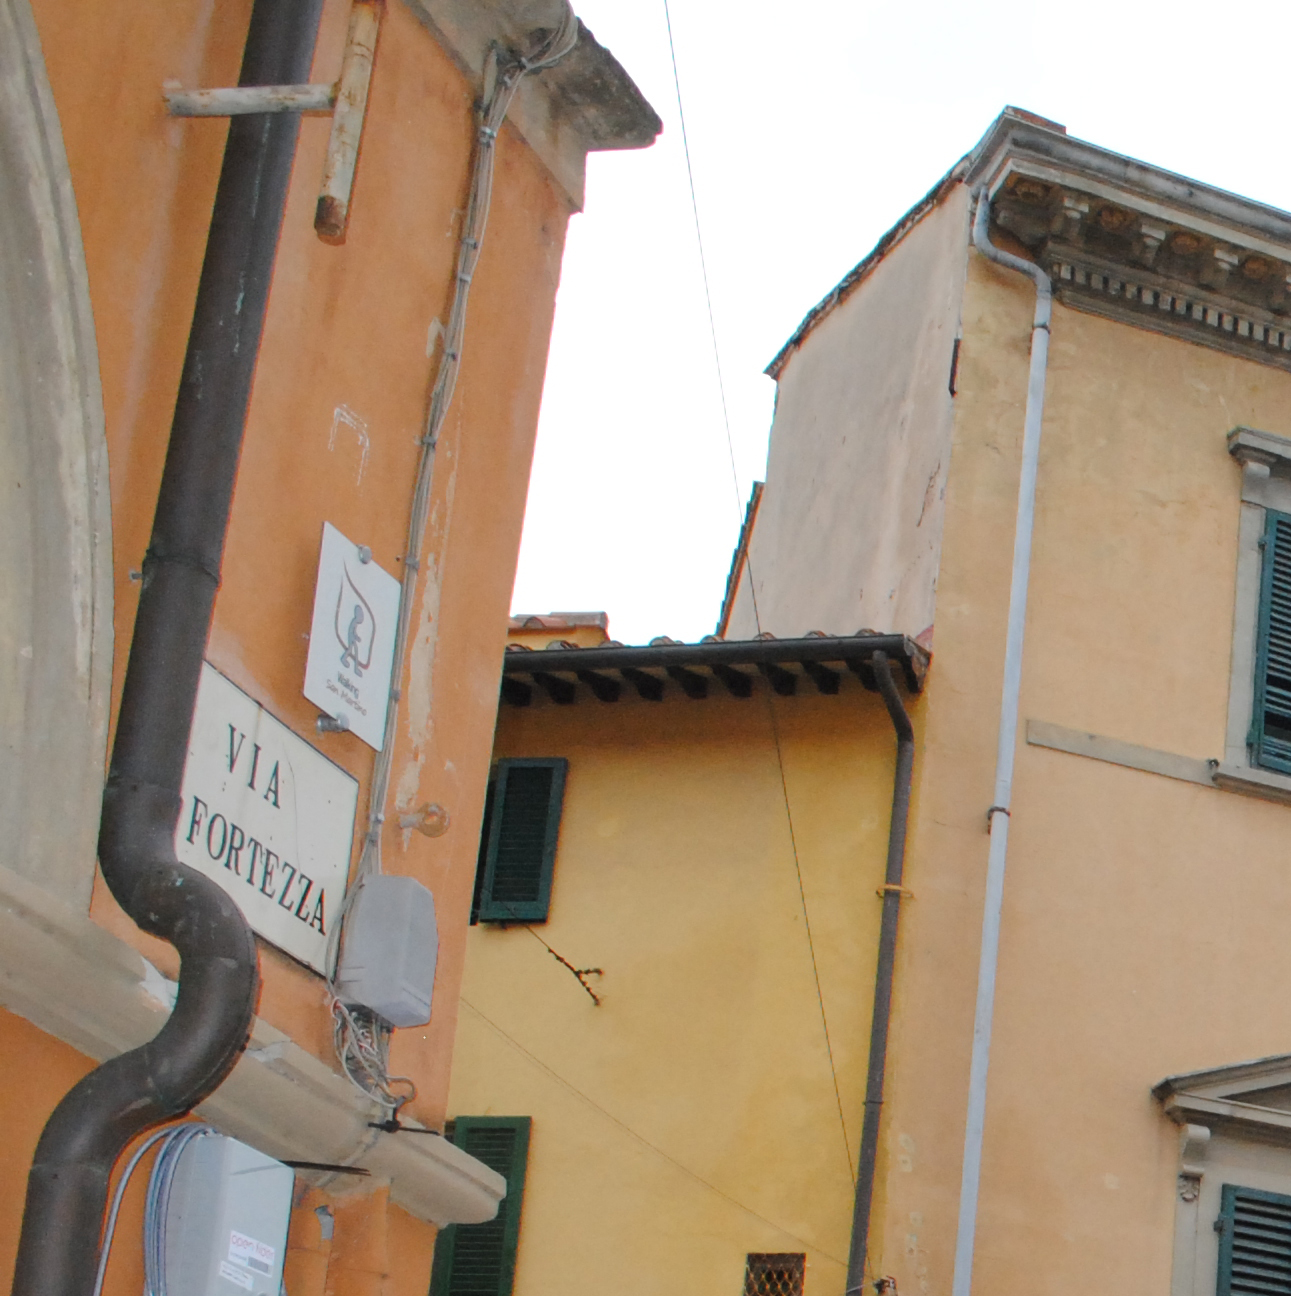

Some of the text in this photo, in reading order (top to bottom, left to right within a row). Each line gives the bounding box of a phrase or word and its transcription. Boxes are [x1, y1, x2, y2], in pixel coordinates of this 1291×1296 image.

[326, 678, 367, 717] San Martino
[337, 670, 359, 700] Walking
[228, 723, 280, 809] VIA
[186, 795, 326, 936] FORTEZZA
